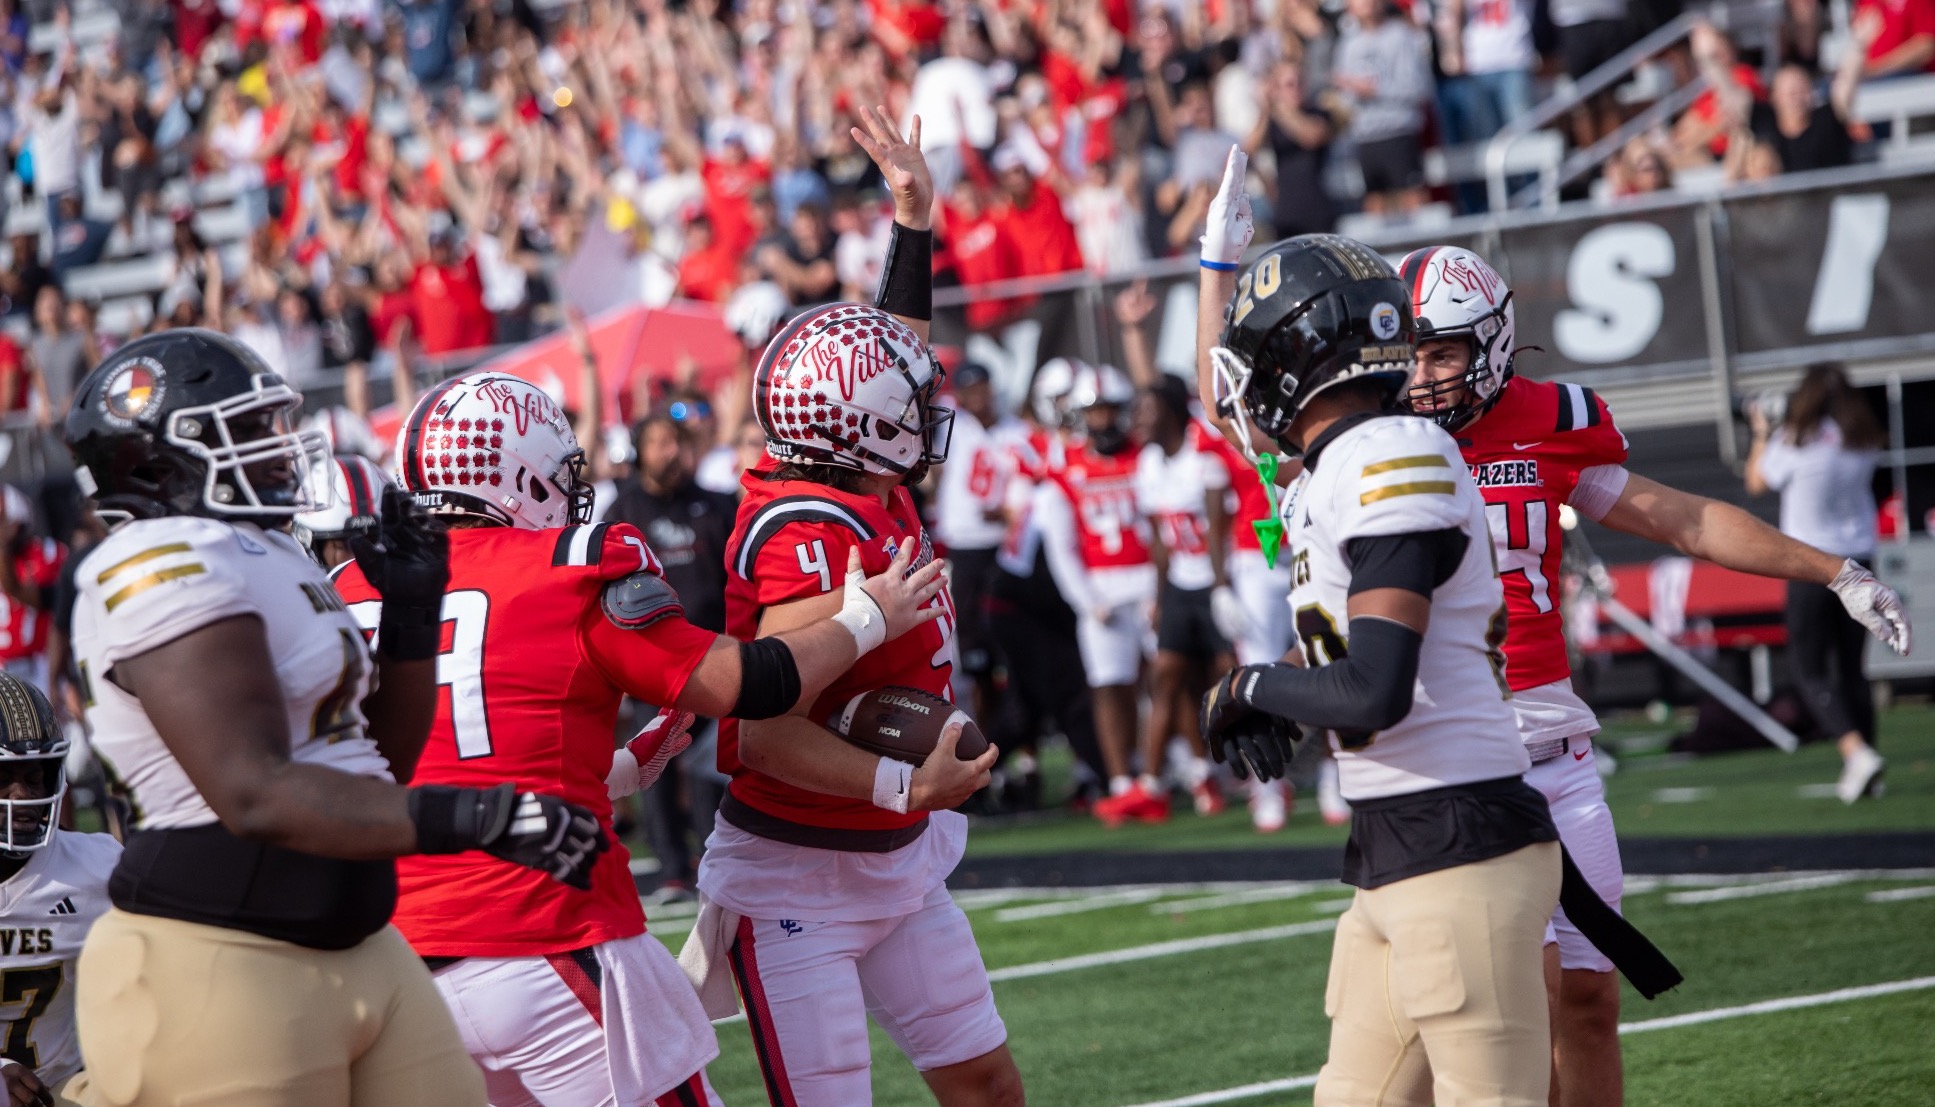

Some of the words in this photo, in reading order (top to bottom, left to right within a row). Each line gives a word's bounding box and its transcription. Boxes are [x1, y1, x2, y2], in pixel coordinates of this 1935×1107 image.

[1234, 253, 1281, 327] 20
[1443, 259, 1468, 292] The
[1556, 224, 1675, 362] S
[802, 336, 838, 381] The
[826, 338, 895, 402] Ville
[476, 380, 512, 412] The
[795, 539, 832, 592] 4
[878, 694, 931, 715] Wilson
[878, 726, 901, 738] NCAA
